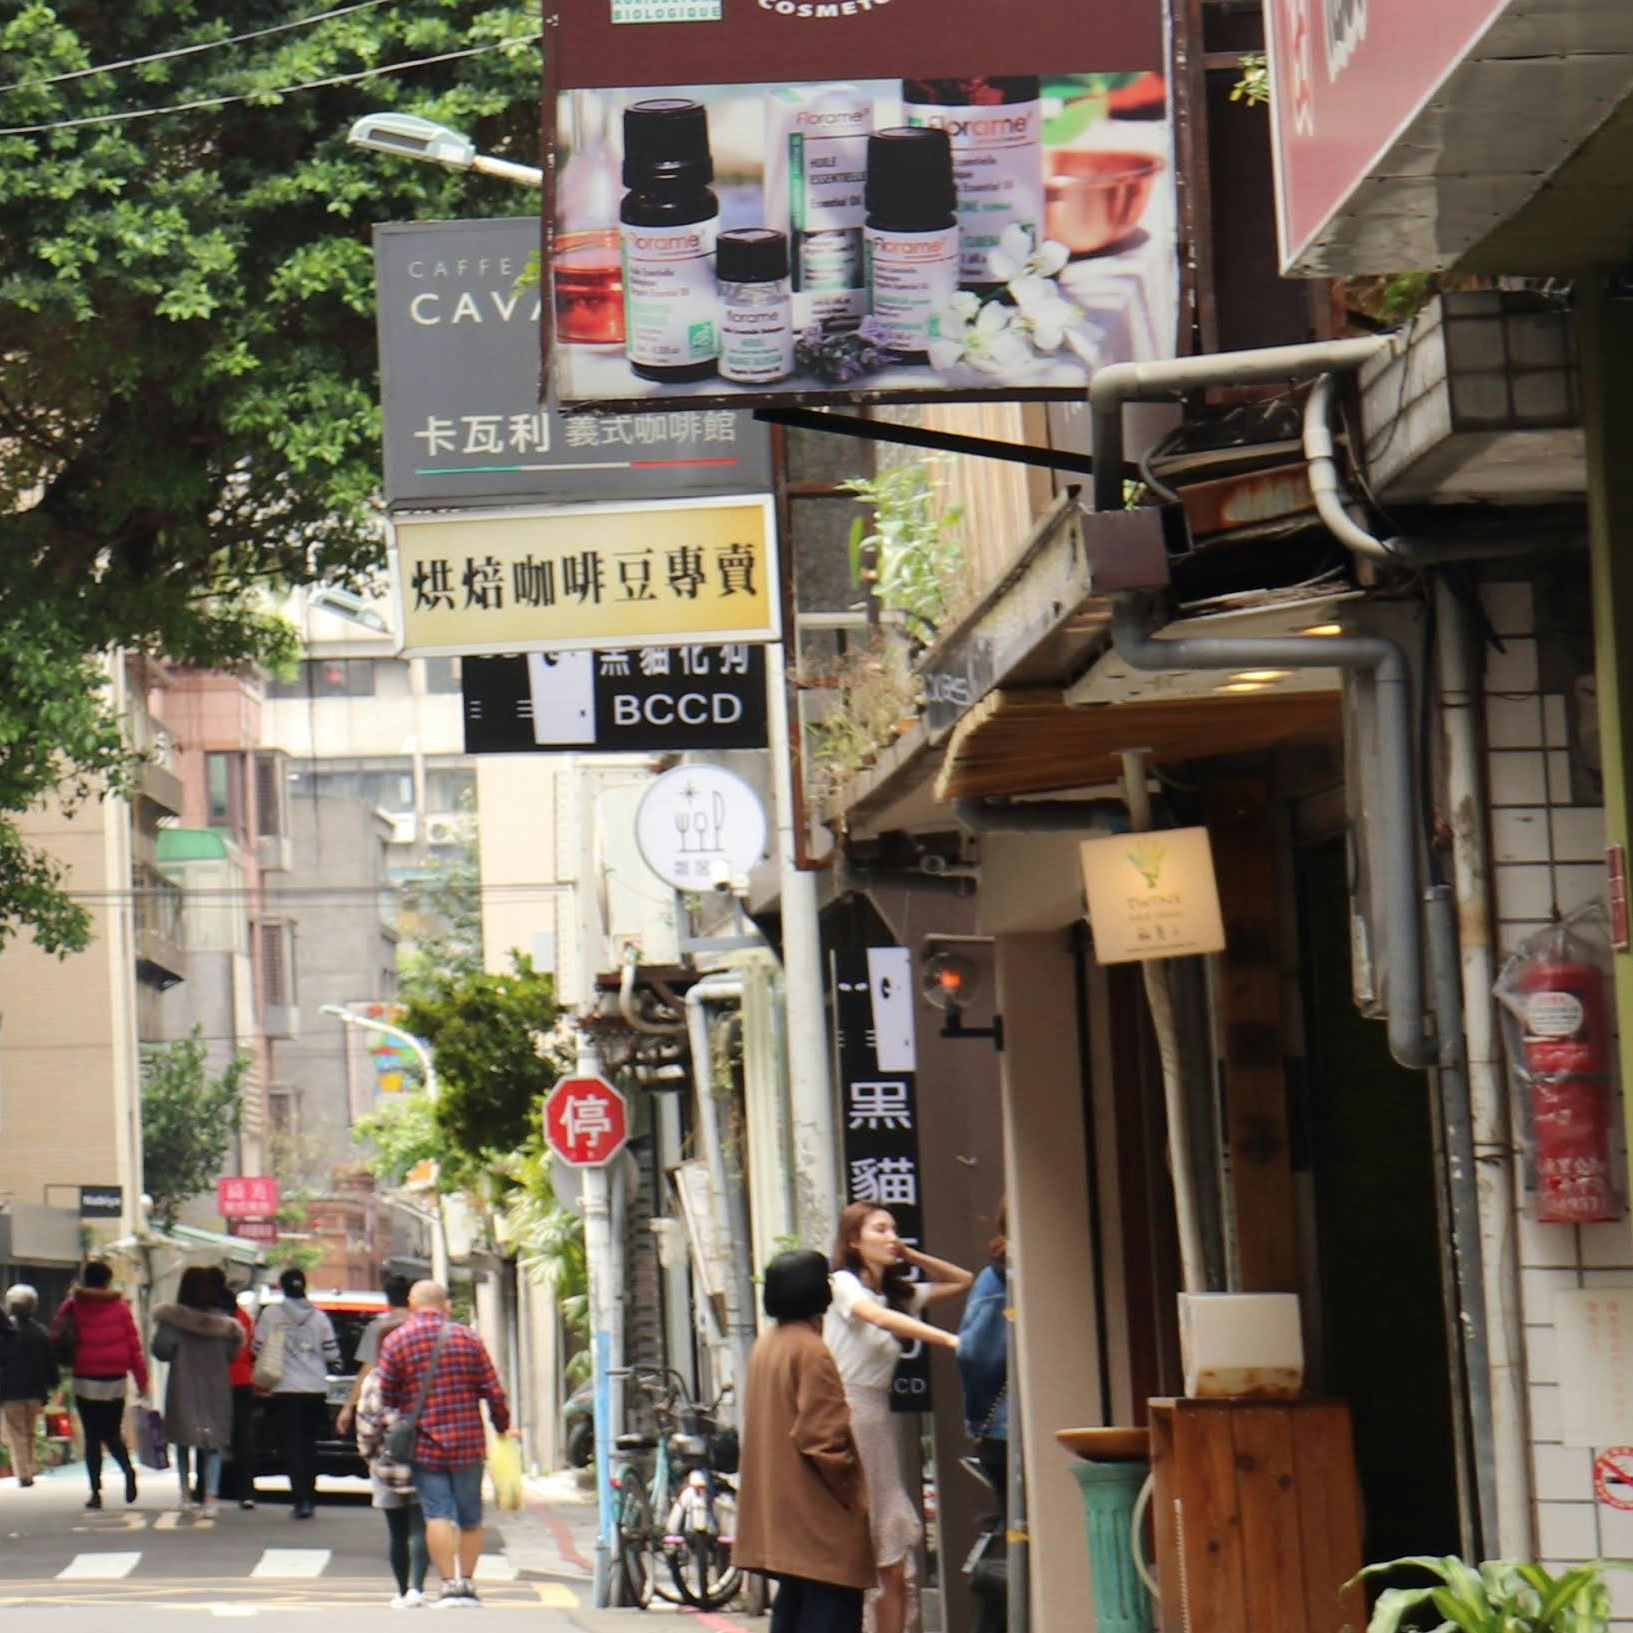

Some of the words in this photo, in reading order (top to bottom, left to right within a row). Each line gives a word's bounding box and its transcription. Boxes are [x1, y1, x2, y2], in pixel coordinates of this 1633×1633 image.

[415, 412, 551, 457] 卡瓦利
[567, 411, 738, 449] 義式咖啡館
[411, 542, 758, 613] 烘焙咖啡豆專賣
[613, 694, 742, 726] BCCD
[560, 1095, 612, 1149] 停
